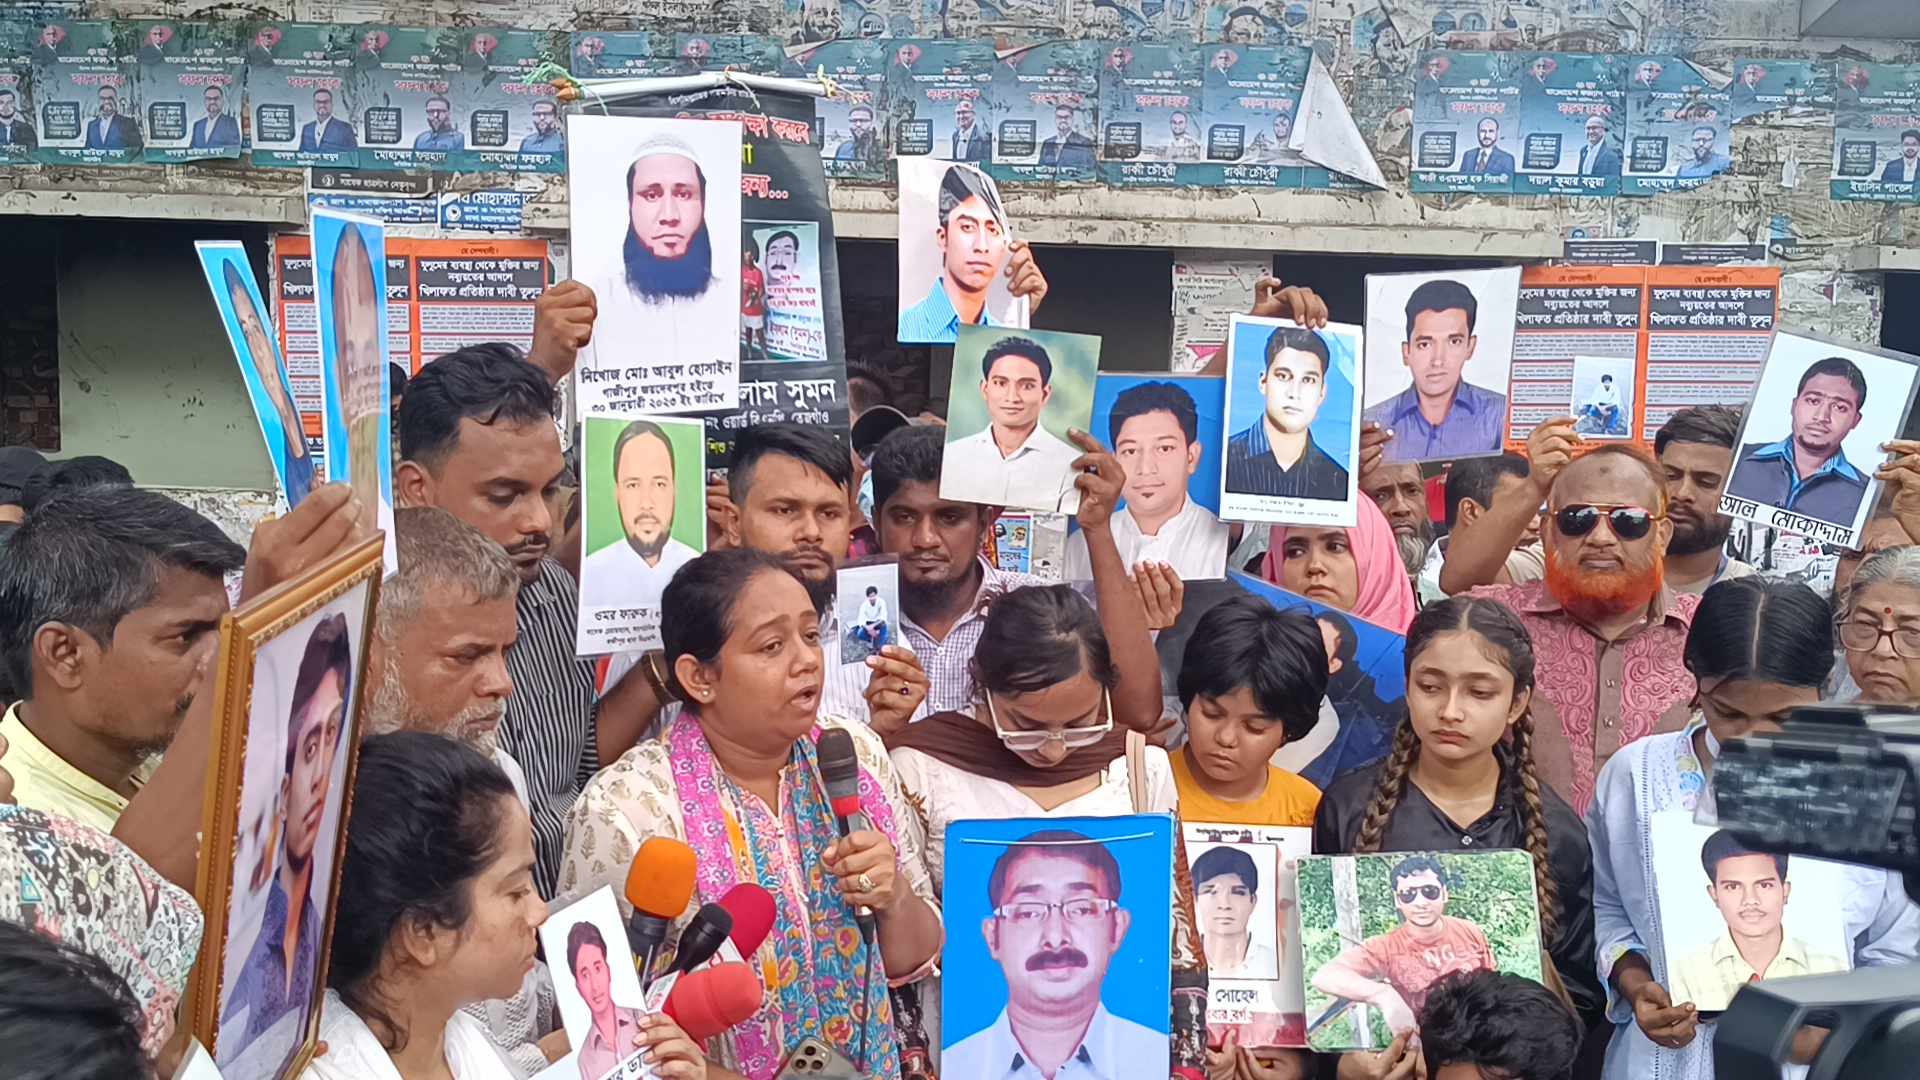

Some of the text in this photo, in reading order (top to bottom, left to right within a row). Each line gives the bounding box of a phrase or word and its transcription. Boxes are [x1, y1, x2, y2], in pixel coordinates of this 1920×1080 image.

[472, 191, 521, 206] মোহাম্মদ
[474, 260, 496, 271] থেকে
[522, 260, 540, 271] জন্য
[459, 283, 496, 298] প্রতিষ্ঠার
[1571, 288, 1594, 298] থেকে
[1619, 288, 1637, 298] জন্য
[1707, 289, 1729, 299] থেকে
[1754, 289, 1772, 299] জন্য
[1554, 311, 1590, 325] প্রতিষ্ঠার
[1688, 312, 1726, 326] প্রতিষ্ঠার
[625, 366, 648, 380] মোঃ
[652, 364, 684, 381] আবুল
[689, 359, 732, 377] হোসাইন
[603, 384, 637, 399] গাজীপুর
[739, 379, 836, 409] লাম সুমন
[592, 404, 606, 412] ৩০
[649, 397, 676, 409] ২০২৩
[704, 416, 720, 430] নং
[1719, 496, 1759, 520] আল
[1215, 989, 1259, 1004] সোহেল
